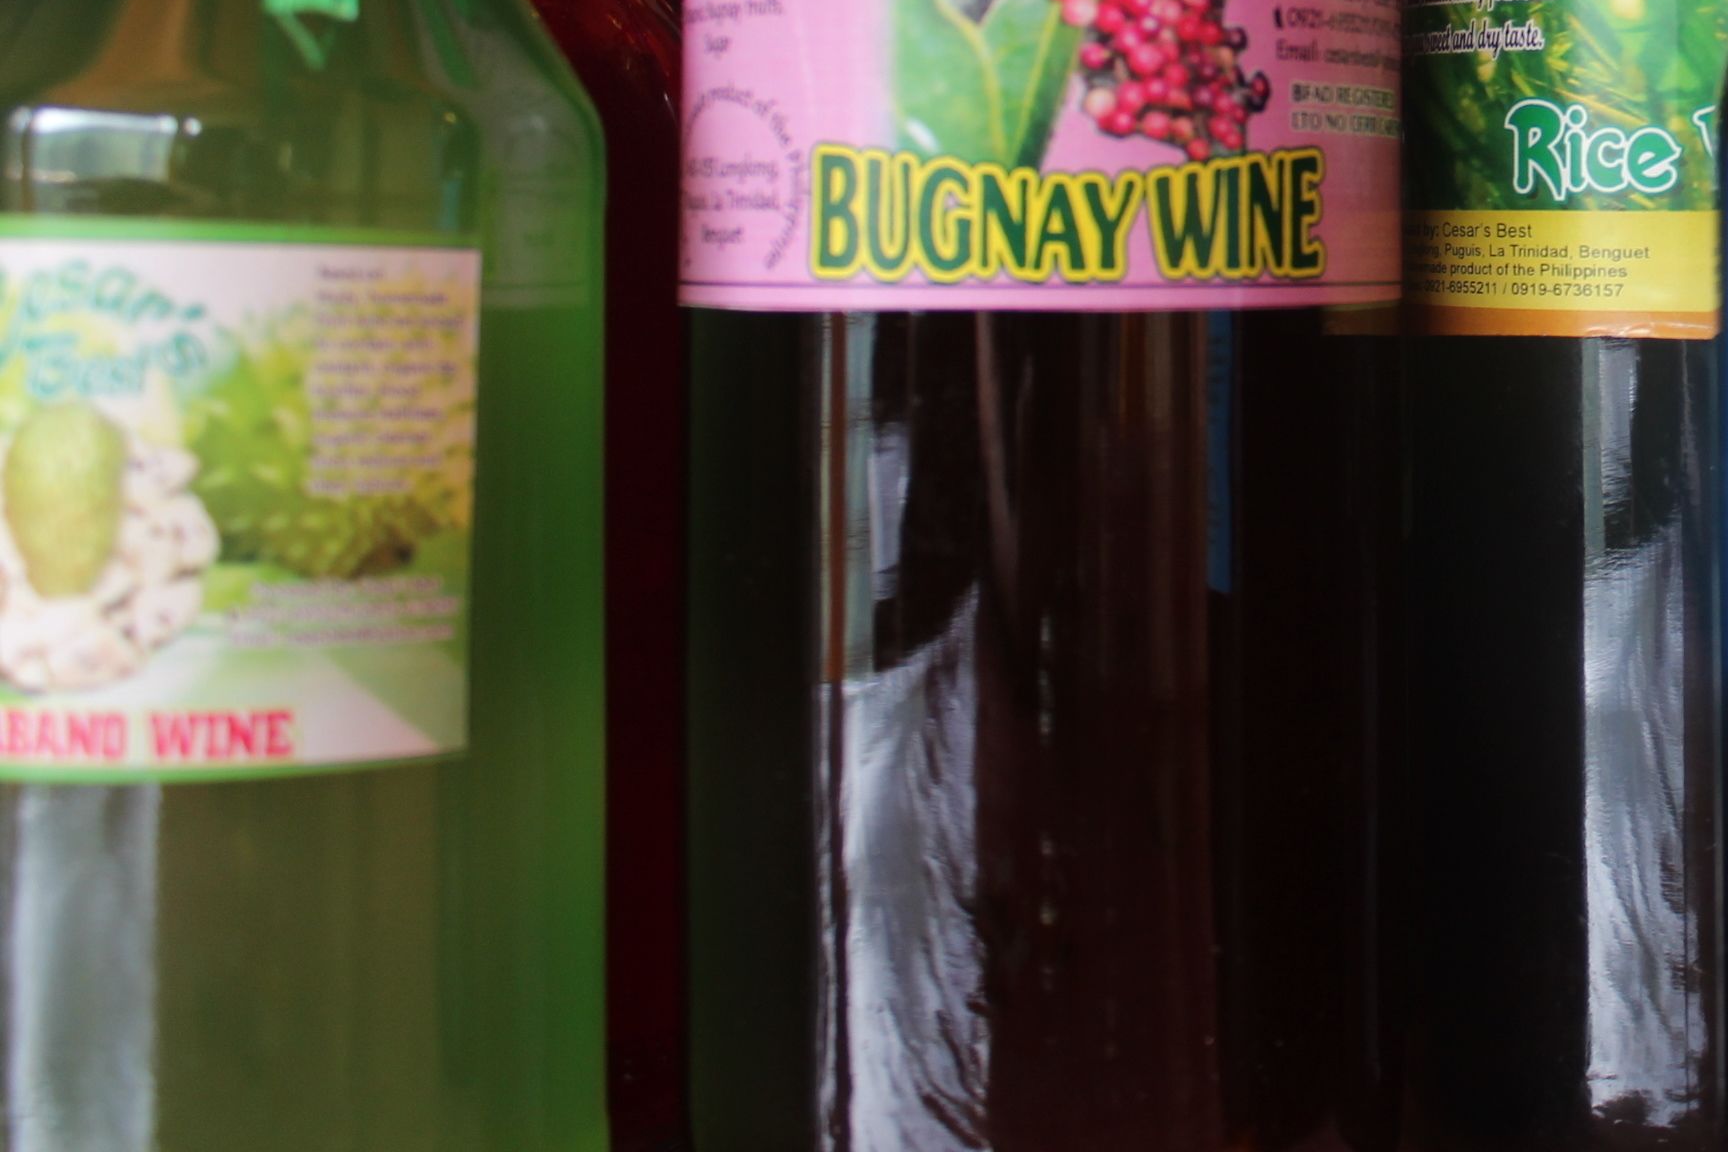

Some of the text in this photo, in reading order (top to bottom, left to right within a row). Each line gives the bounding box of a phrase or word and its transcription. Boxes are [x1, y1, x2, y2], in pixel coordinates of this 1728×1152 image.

[1452, 18, 1477, 52] and
[1477, 17, 1503, 61] dry
[1503, 19, 1545, 51] taste.
[1504, 98, 1682, 200] Rice
[811, 144, 1326, 281] BUGNAY WINE
[1442, 222, 1492, 238] Cesar's
[1496, 223, 1533, 239] Best
[1489, 244, 1505, 257] La
[1510, 244, 1574, 260] Trinidad,
[1579, 245, 1650, 262] Benguet
[1450, 262, 1492, 277] product
[1496, 263, 1510, 276] of
[1513, 263, 1535, 276] the
[1540, 263, 1628, 279] Philippines
[1511, 281, 1625, 297] 0919-6736157
[147, 708, 296, 761] WINE
